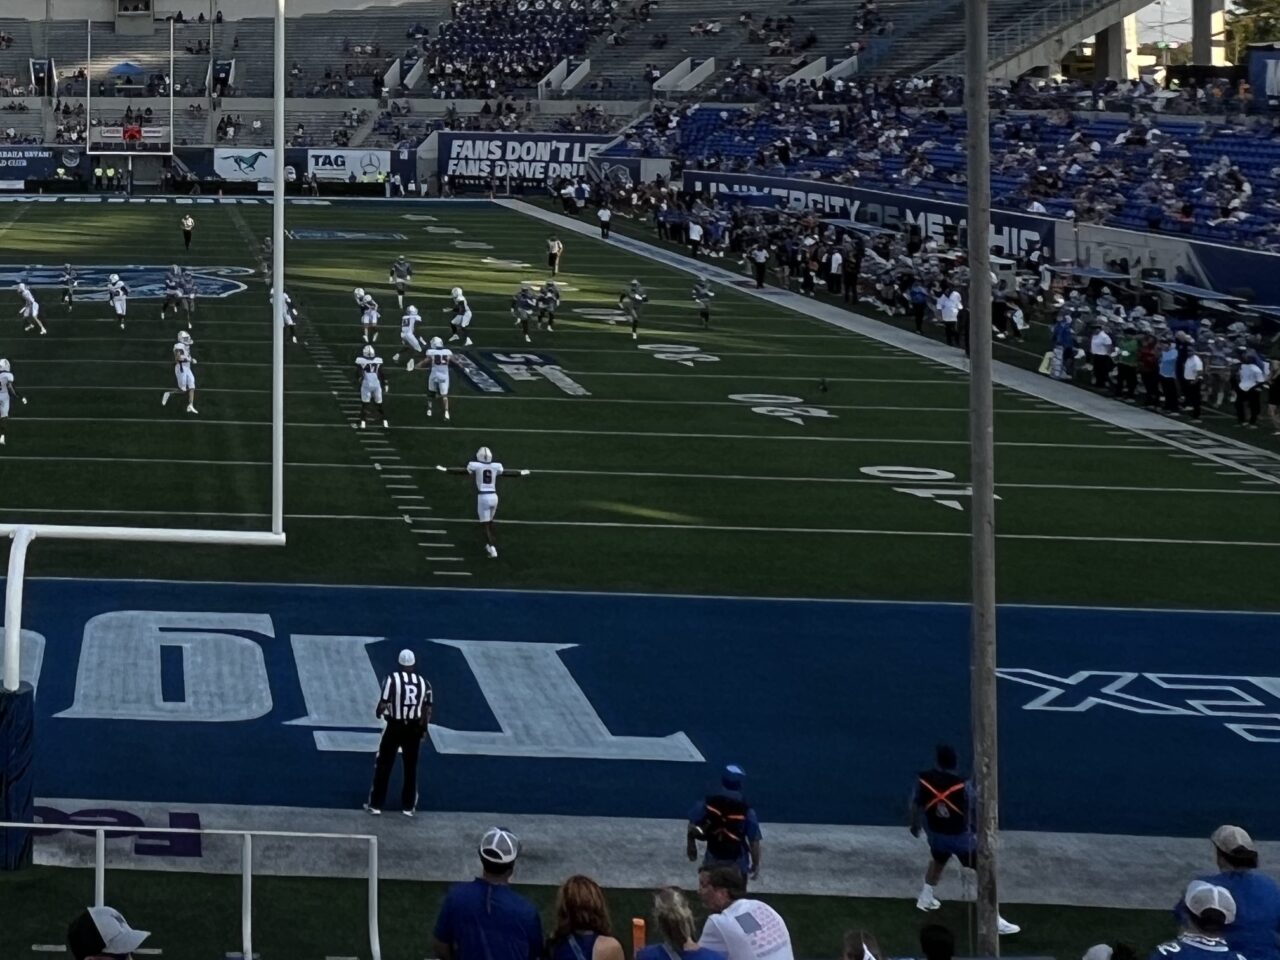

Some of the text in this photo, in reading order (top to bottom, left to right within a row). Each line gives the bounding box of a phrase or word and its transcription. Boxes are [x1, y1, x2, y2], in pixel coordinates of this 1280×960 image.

[311, 154, 346, 167] TAG
[450, 139, 502, 160] FANS
[505, 140, 570, 162] DON'T
[447, 159, 493, 177] FANS
[494, 161, 546, 179] DRIVE
[403, 684, 418, 705] R
